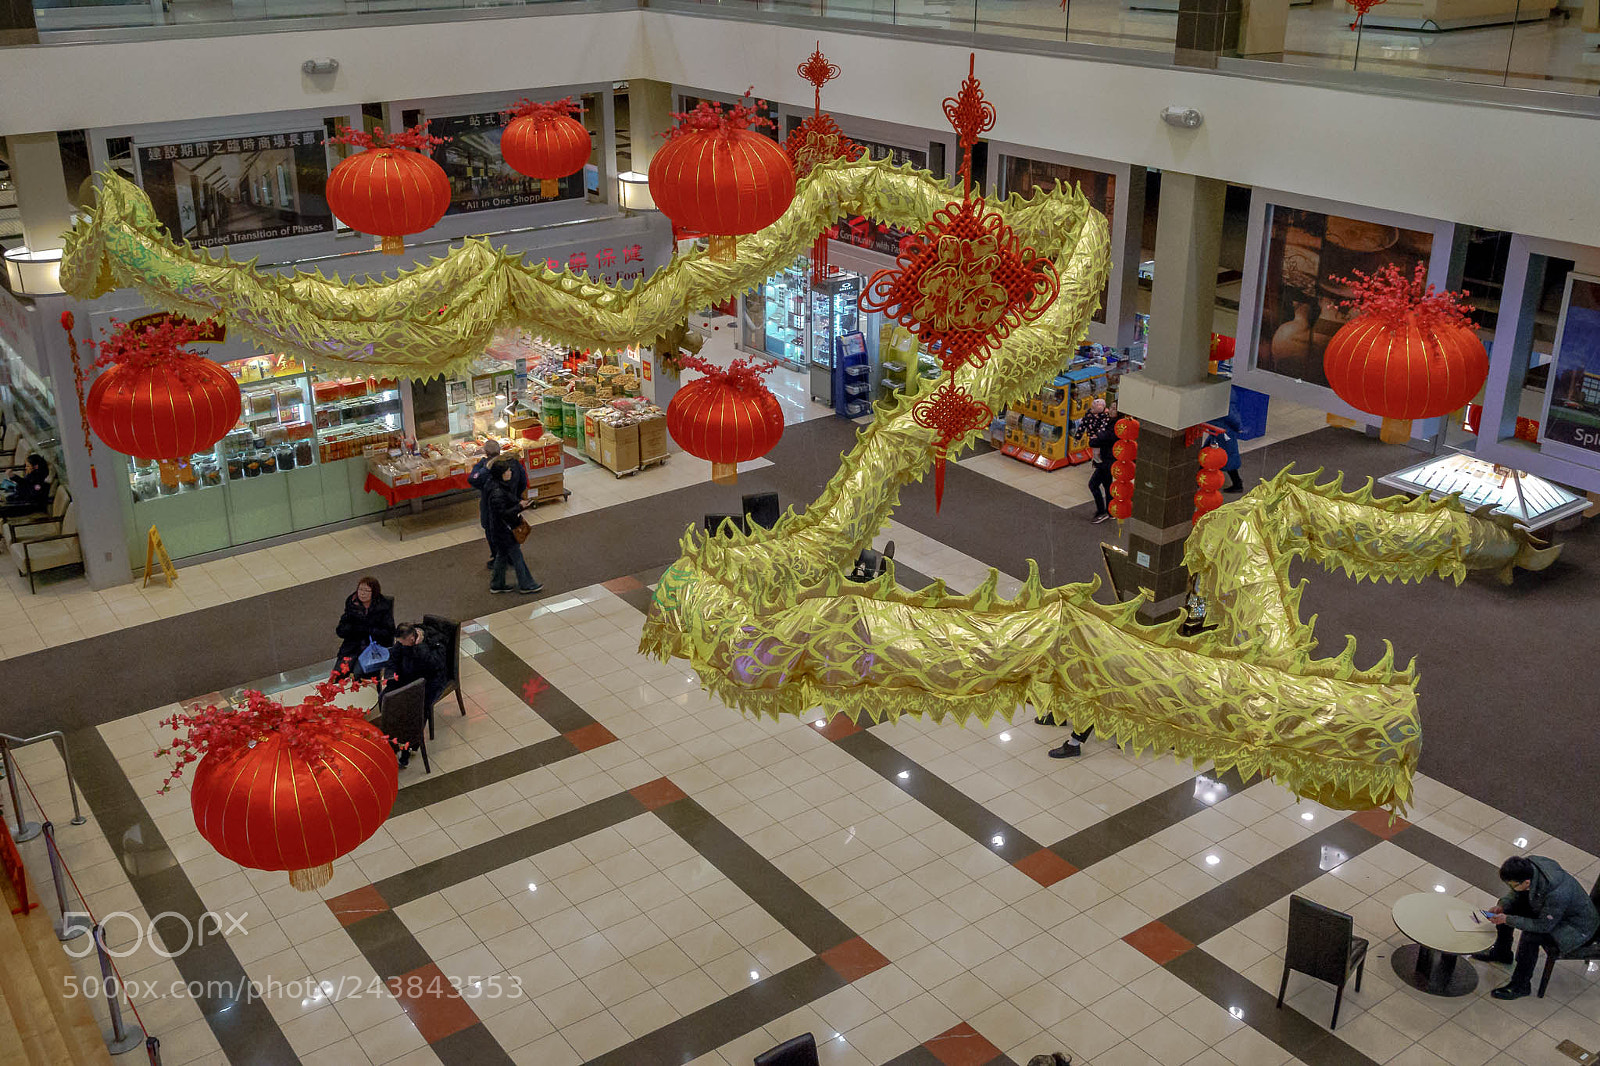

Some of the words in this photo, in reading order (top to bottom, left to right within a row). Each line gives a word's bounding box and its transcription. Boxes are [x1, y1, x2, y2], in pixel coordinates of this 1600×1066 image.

[492, 197, 511, 206] One
[233, 228, 278, 242] Transition
[280, 225, 291, 235] of
[292, 223, 324, 234] Phases
[616, 267, 645, 283] Food
[1573, 428, 1600, 446] Spl
